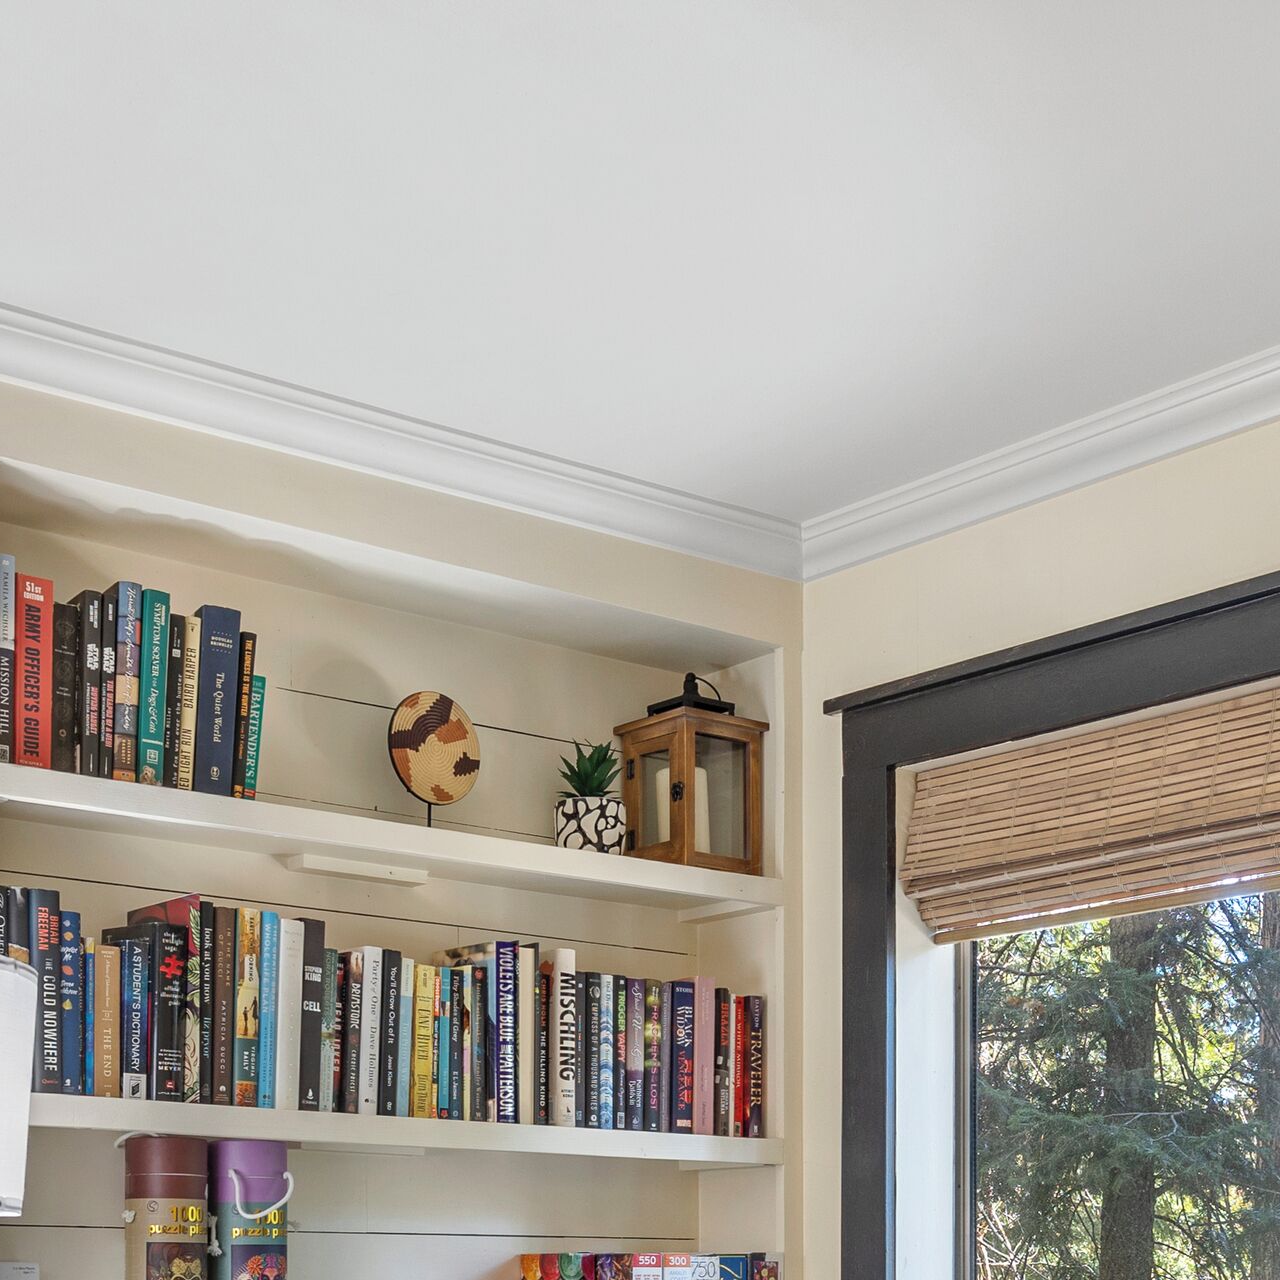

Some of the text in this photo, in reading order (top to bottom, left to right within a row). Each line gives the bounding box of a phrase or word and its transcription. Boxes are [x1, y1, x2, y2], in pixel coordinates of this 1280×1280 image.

[24, 592, 44, 602] EDITION
[24, 604, 41, 642] ARMY
[87, 644, 95, 668] WARS
[91, 644, 99, 670] STAR
[103, 647, 111, 672] WARS
[107, 648, 115, 673] STAR
[148, 603, 162, 706] SYMPTOM SOLVER Dogs
[24, 646, 40, 712] OFFICER'S
[0, 656, 9, 735] MISSION HILL
[213, 673, 224, 742] The Quiet World
[181, 648, 196, 774] LIGHT RUN BAIRD HARPER
[24, 718, 39, 757] GUIDE
[246, 692, 262, 777] BARTENDER'S
[38, 907, 49, 950] FREEMAN
[50, 916, 58, 944] BRIAN
[203, 928, 212, 949] look
[219, 934, 223, 944] OF
[226, 928, 231, 936] IN
[203, 950, 212, 960] at
[132, 956, 141, 1009] STUDENT'S
[201, 962, 210, 982] you
[305, 974, 321, 982] KING
[371, 960, 379, 987] Party
[303, 1000, 320, 1012] CELL
[499, 947, 514, 1041] VIOLETS ARE BLUE
[43, 958, 58, 1071] THE COLD NOWHERE
[203, 1018, 211, 1029] liz
[559, 972, 575, 1081] MISCHLING
[617, 991, 625, 1062] TRIGGER YAPPY
[684, 1006, 692, 1048] BLACK
[131, 1012, 140, 1071] DICTIONARY
[201, 1031, 210, 1058] pryor
[369, 1026, 377, 1049] Dave
[388, 1028, 394, 1036] of
[417, 1008, 430, 1061] CANE RIVER
[591, 1036, 598, 1044] OF
[104, 1028, 112, 1077] THE END
[590, 1054, 598, 1088] THOUSAND
[685, 1060, 693, 1103] RED
[751, 1029, 762, 1107] TRAVELER
[499, 1055, 515, 1116] PATTERSON
[628, 1080, 636, 1105] Baldwin
[590, 1091, 598, 1110] SKIES
[170, 1206, 204, 1222] 1000
[149, 1224, 188, 1236] puzzle
[232, 1226, 270, 1239] puzzle
[639, 1256, 656, 1265] 550
[669, 1257, 687, 1265] 300
[692, 1261, 716, 1278] 750
